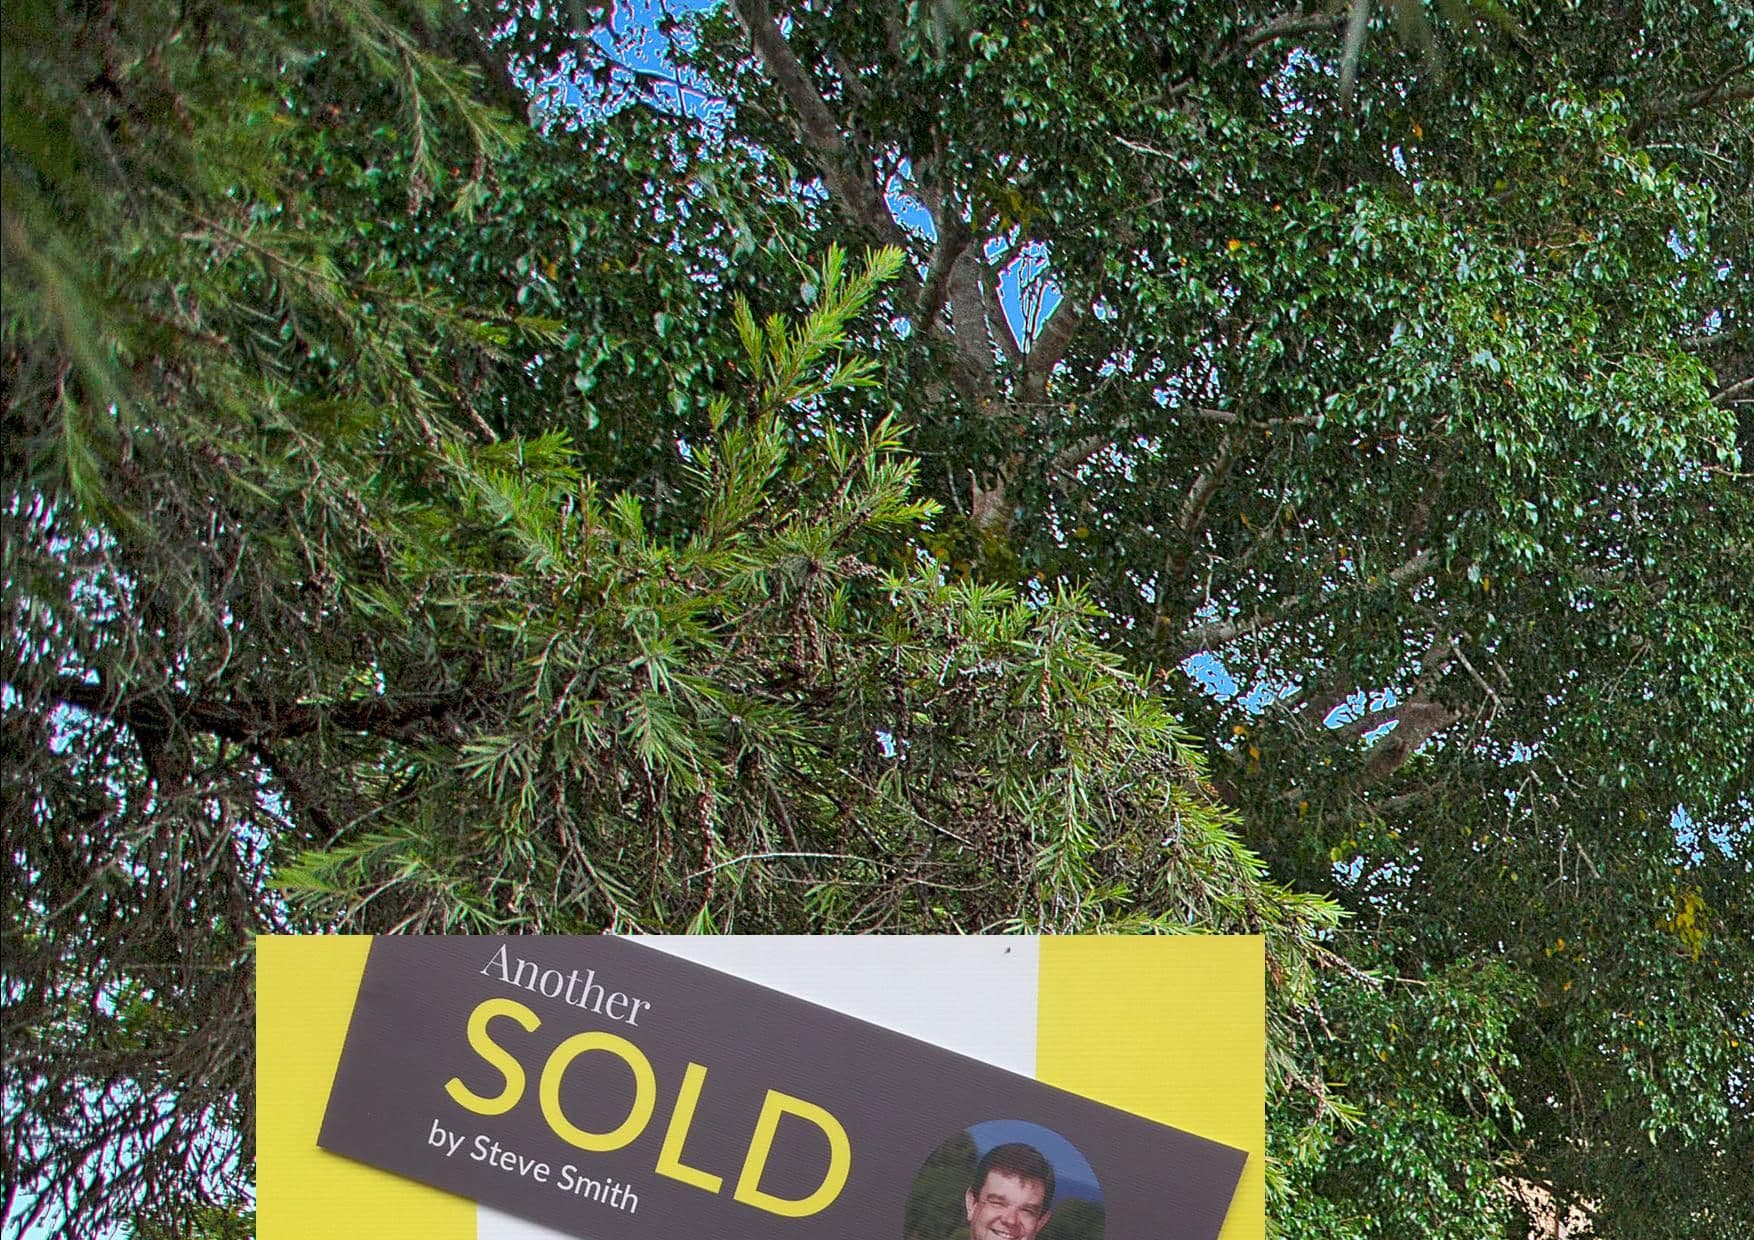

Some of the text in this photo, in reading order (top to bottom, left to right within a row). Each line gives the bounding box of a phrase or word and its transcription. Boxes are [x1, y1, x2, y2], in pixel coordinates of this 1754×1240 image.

[480, 943, 651, 1027] Another
[444, 997, 852, 1218] SOLD
[428, 1118, 639, 1214] by Steve Smith
